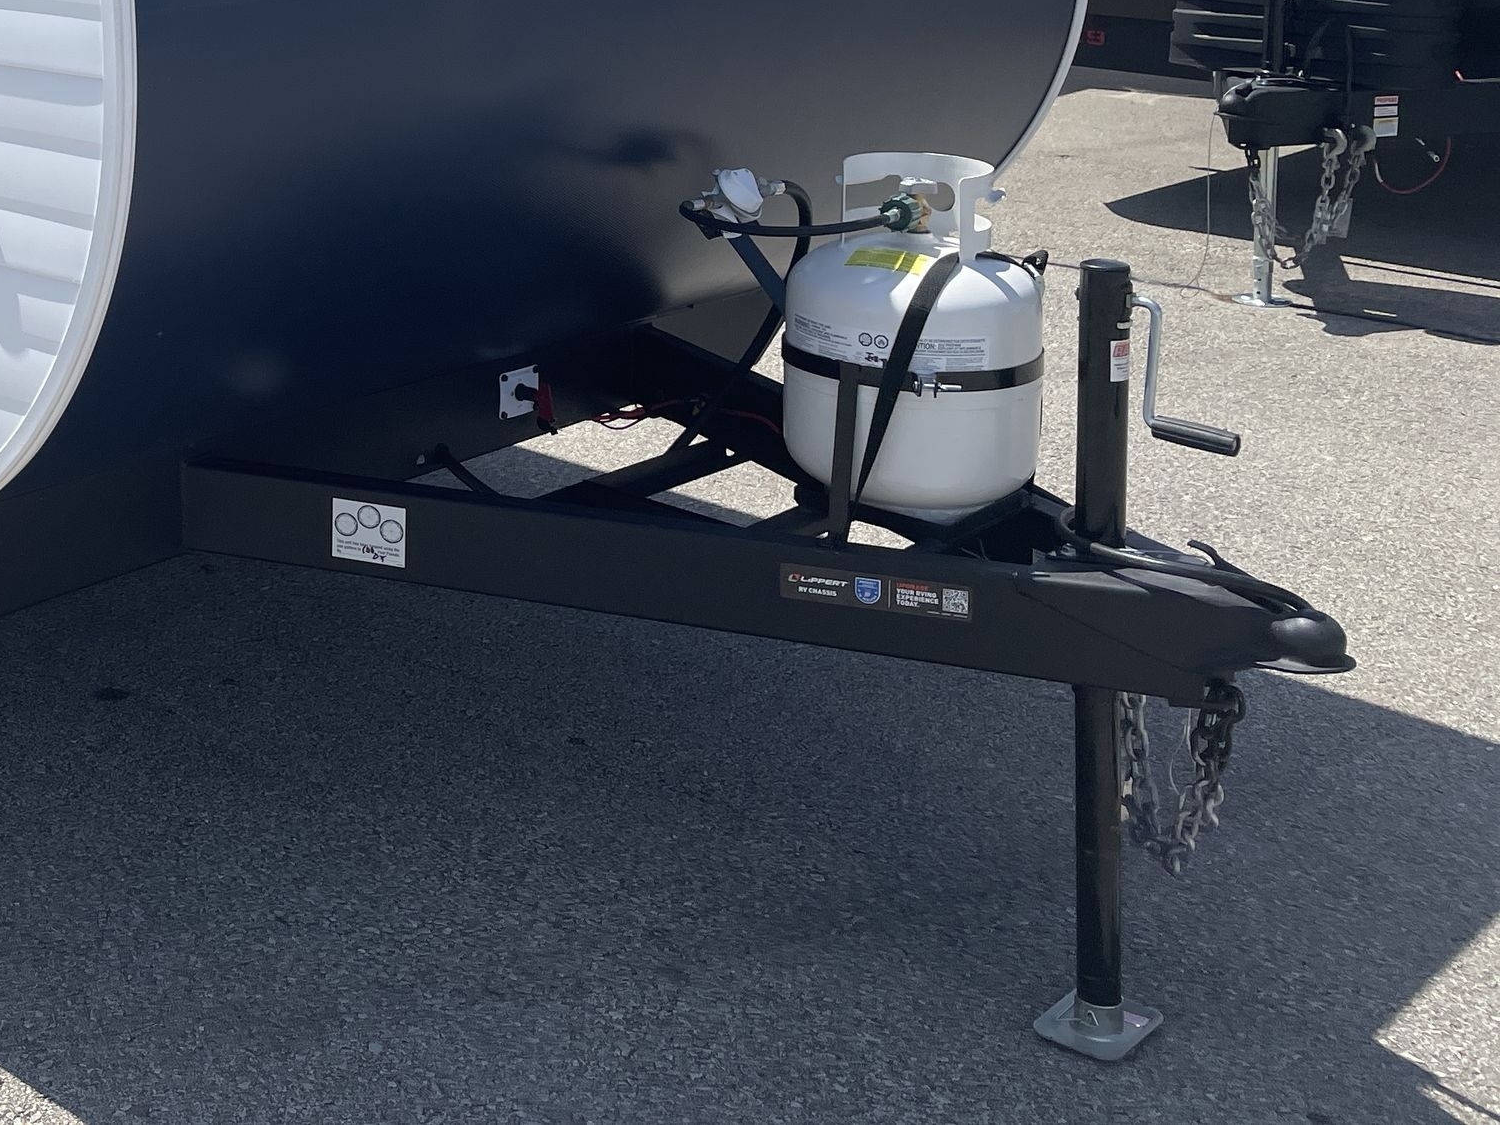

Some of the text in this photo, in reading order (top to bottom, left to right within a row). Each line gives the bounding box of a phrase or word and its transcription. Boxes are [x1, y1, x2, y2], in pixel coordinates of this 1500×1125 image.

[798, 586, 837, 597] RV CHASSIS
[896, 593, 939, 605] EXPERIENCE
